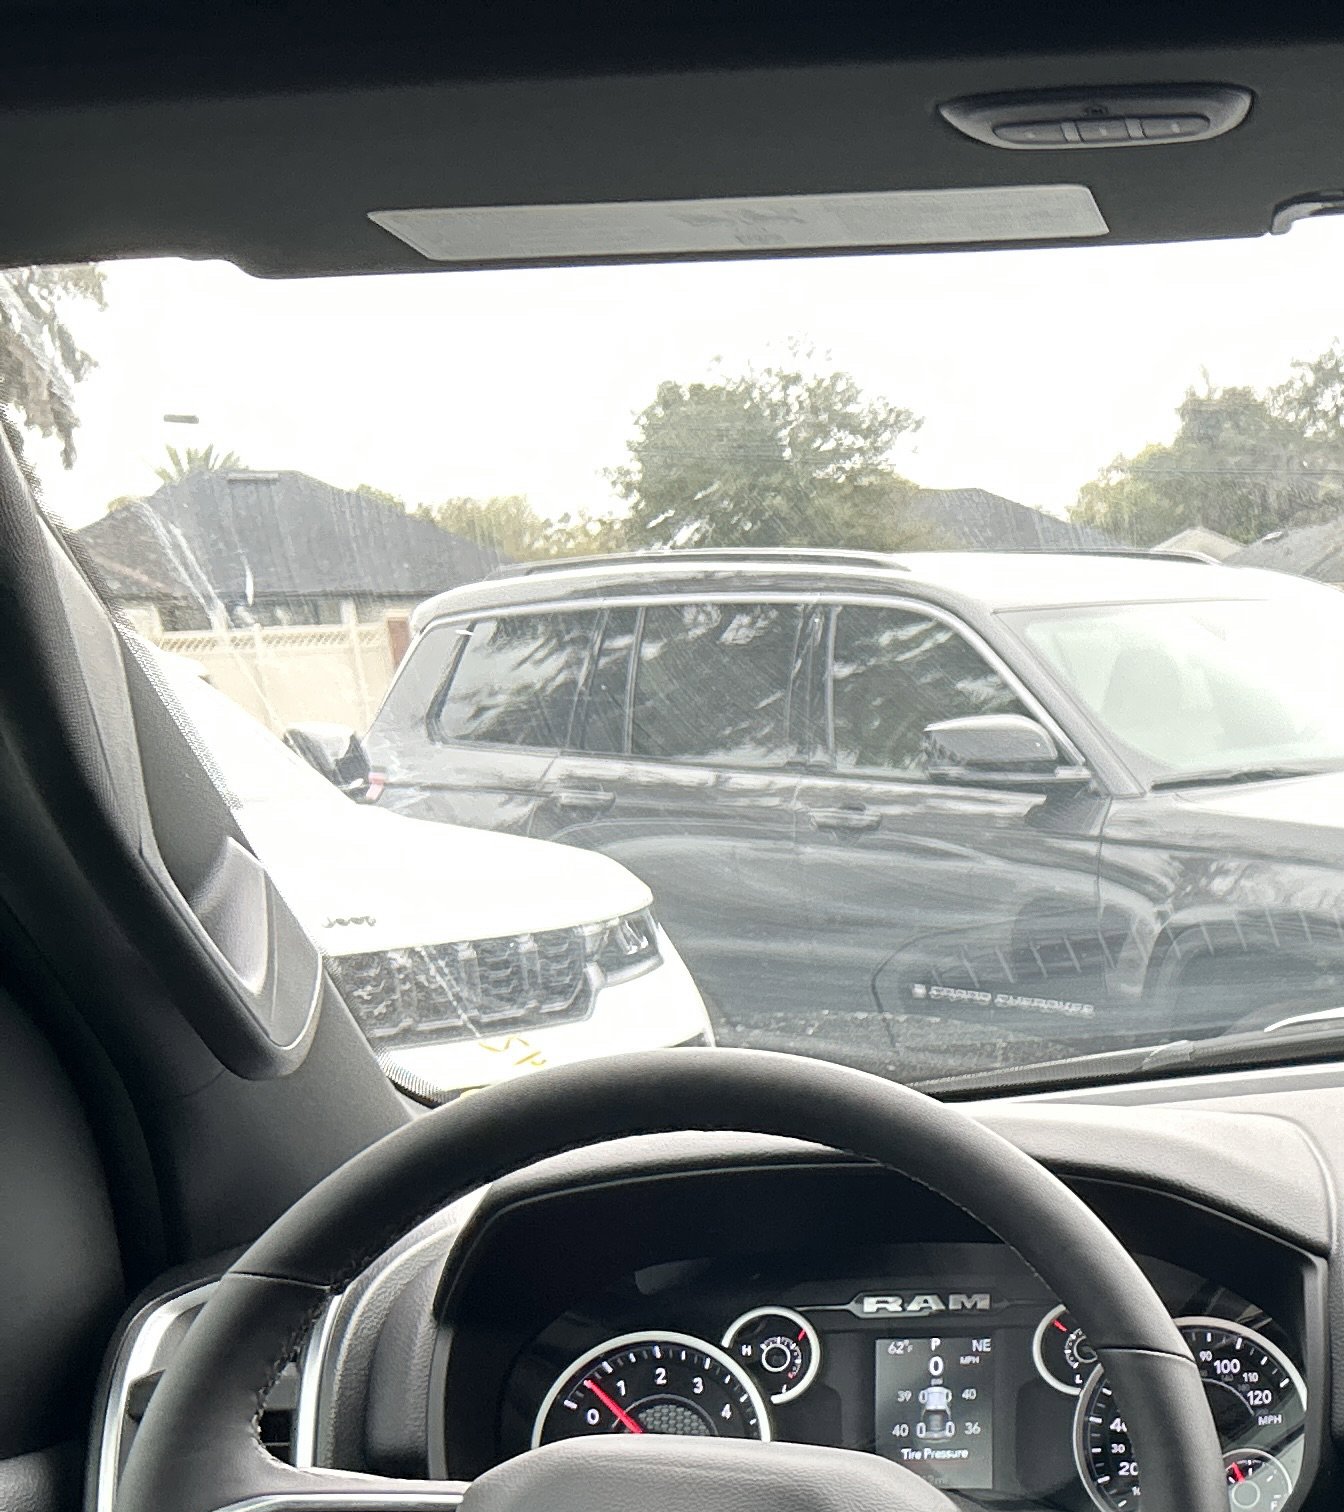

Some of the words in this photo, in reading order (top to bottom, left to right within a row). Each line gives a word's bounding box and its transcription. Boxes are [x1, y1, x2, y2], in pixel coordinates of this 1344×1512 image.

[863, 1293, 991, 1313] RAM
[930, 1337, 941, 1351] P
[971, 1338, 992, 1352] NE
[928, 1355, 944, 1376] 0
[1213, 1358, 1241, 1375] 100
[655, 1367, 668, 1385] 2
[616, 1379, 626, 1397] 1
[692, 1377, 704, 1394] 3
[1246, 1390, 1272, 1405] 120
[586, 1408, 600, 1425] 0
[721, 1403, 732, 1420] 4
[892, 1424, 909, 1437] 40
[964, 1422, 982, 1435] 36
[902, 1448, 921, 1460] Tire
[923, 1448, 969, 1460] Pressure
[1111, 1443, 1126, 1454] 30
